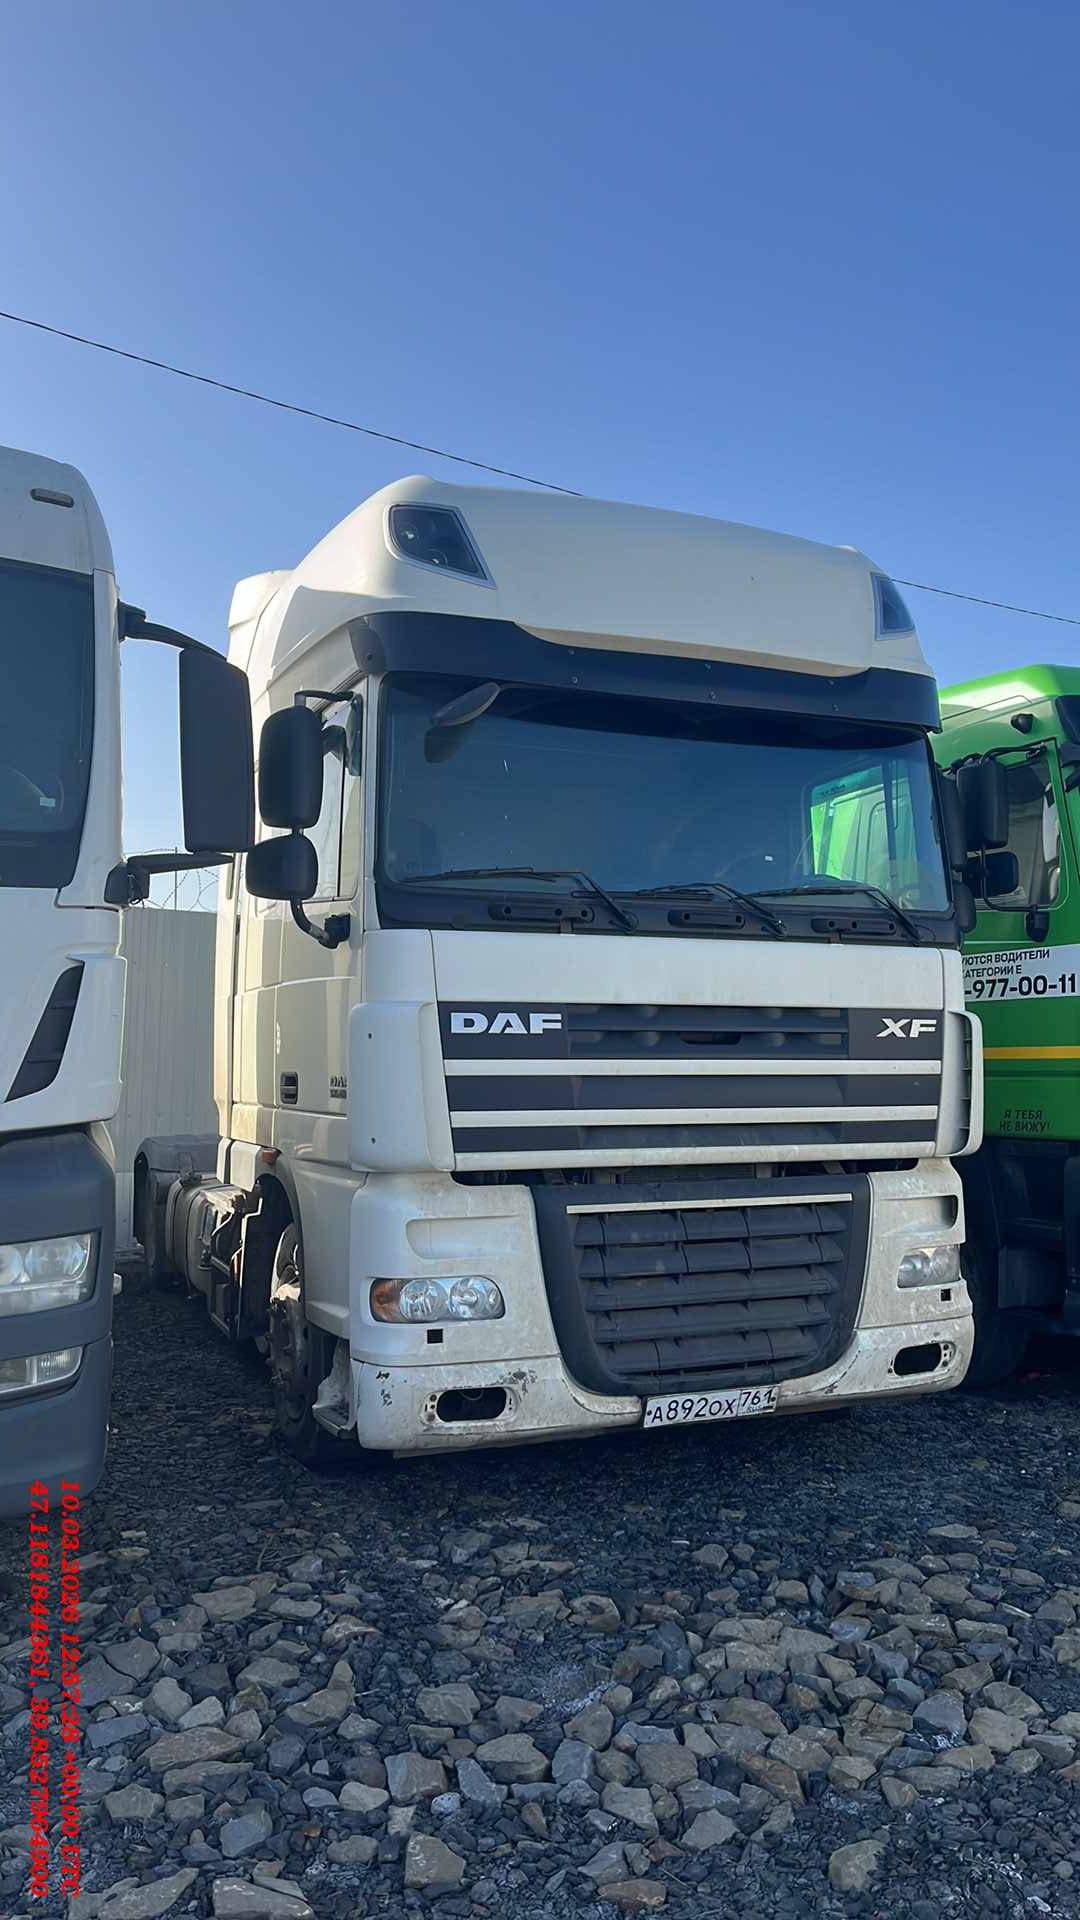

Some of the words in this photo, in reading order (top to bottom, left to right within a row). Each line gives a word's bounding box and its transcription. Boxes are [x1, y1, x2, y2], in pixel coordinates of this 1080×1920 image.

[994, 949, 1050, 964] ВОДИТЕЛИ
[962, 966, 1016, 979] АТЕГОРИИ
[450, 1012, 562, 1034] DAF
[876, 1018, 937, 1038] XF
[1004, 1110, 1012, 1119] Я
[1016, 1109, 1043, 1120] ТЕБЯ
[1000, 1120, 1012, 1132] НЕ
[742, 1389, 773, 1407] 761
